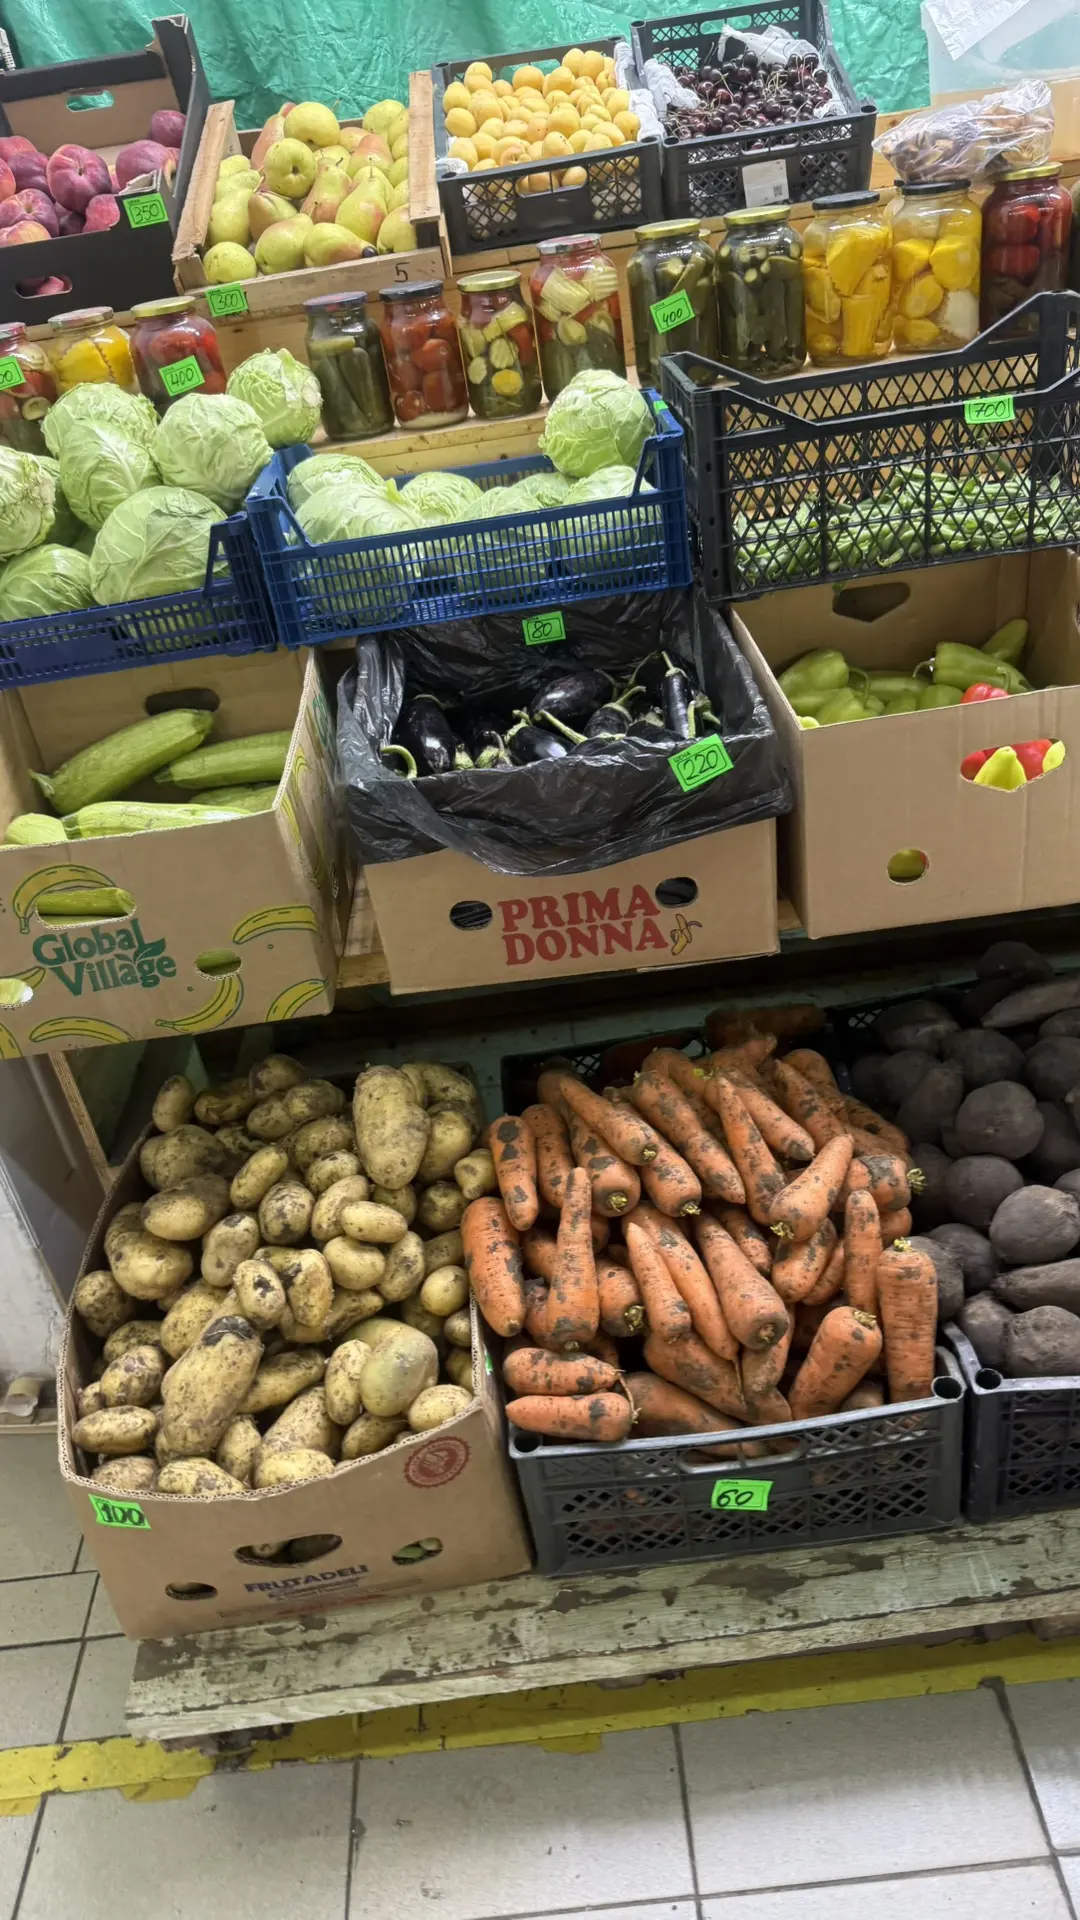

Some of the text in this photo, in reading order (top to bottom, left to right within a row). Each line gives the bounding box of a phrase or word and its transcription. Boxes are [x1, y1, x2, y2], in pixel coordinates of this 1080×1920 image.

[134, 203, 160, 225] 350
[394, 261, 410, 282] 5
[216, 293, 239, 310] 300
[662, 308, 683, 327] 400
[170, 367, 194, 386] 400
[973, 400, 1006, 418] 700
[532, 620, 552, 638] 80
[683, 750, 718, 780] 220
[497, 884, 661, 932] PRIMA
[32, 917, 166, 966] Global
[502, 918, 669, 966] DONNA
[50, 955, 177, 997] Village
[716, 1488, 754, 1507] 60
[101, 1502, 145, 1526] 100
[243, 1563, 369, 1593] FRUTADELI
